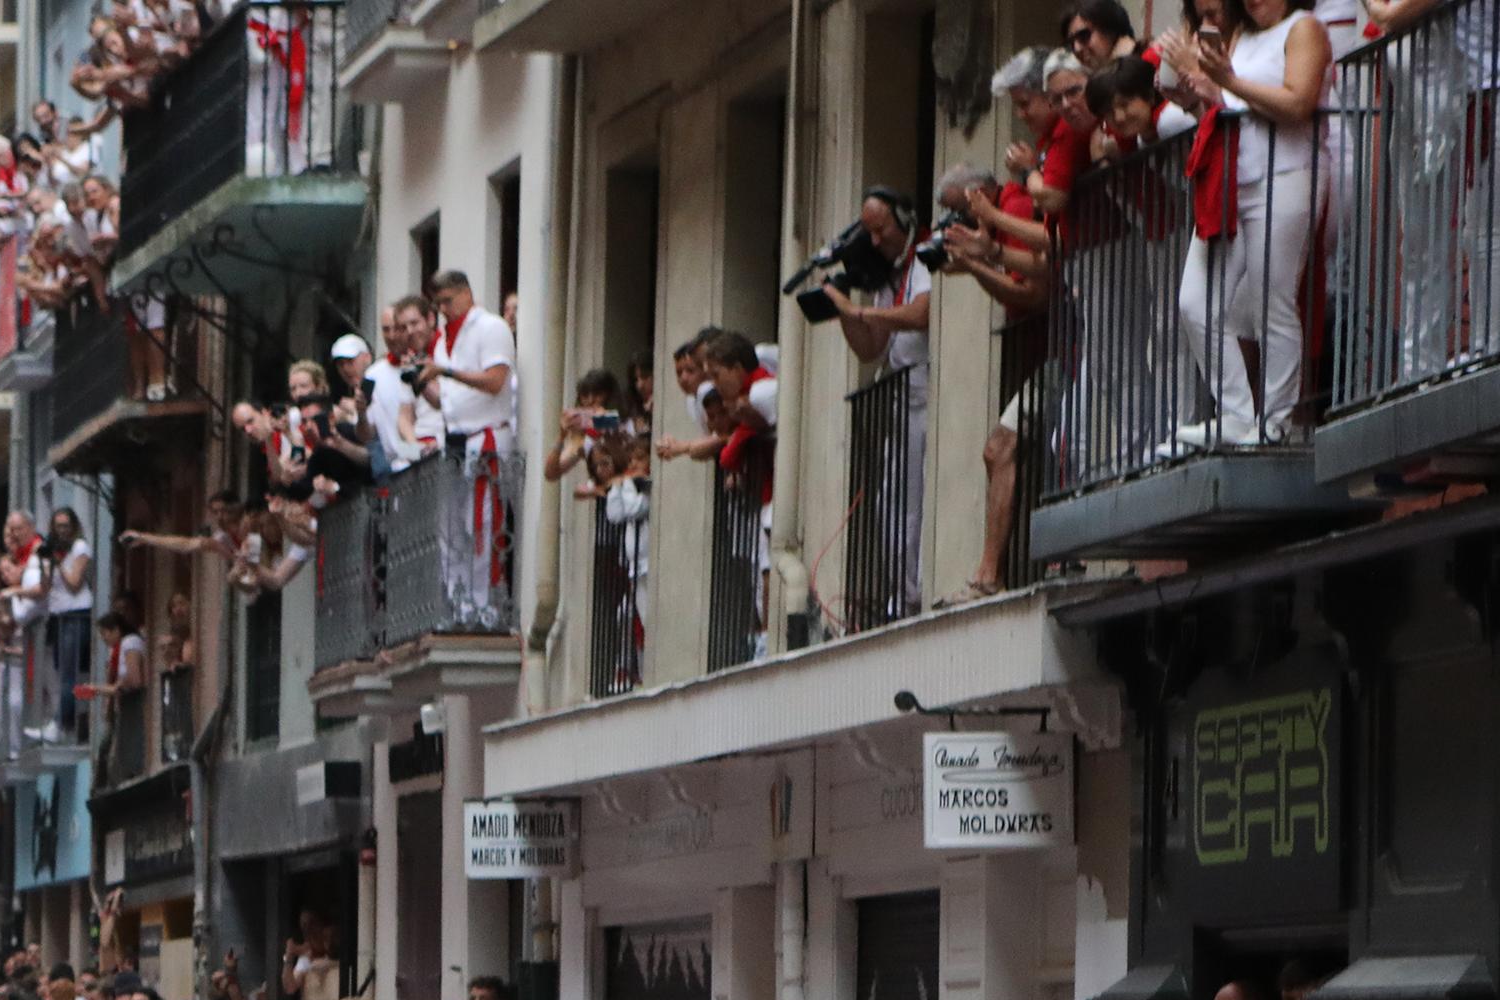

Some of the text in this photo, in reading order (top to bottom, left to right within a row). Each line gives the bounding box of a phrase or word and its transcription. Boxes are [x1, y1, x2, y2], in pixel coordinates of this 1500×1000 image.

[938, 788, 1009, 809] MARCOS
[1195, 752, 1329, 867] CAR
[471, 811, 565, 839] AMADO MENDOZA
[471, 846, 565, 866] MARCOS Y MOLDURAS
